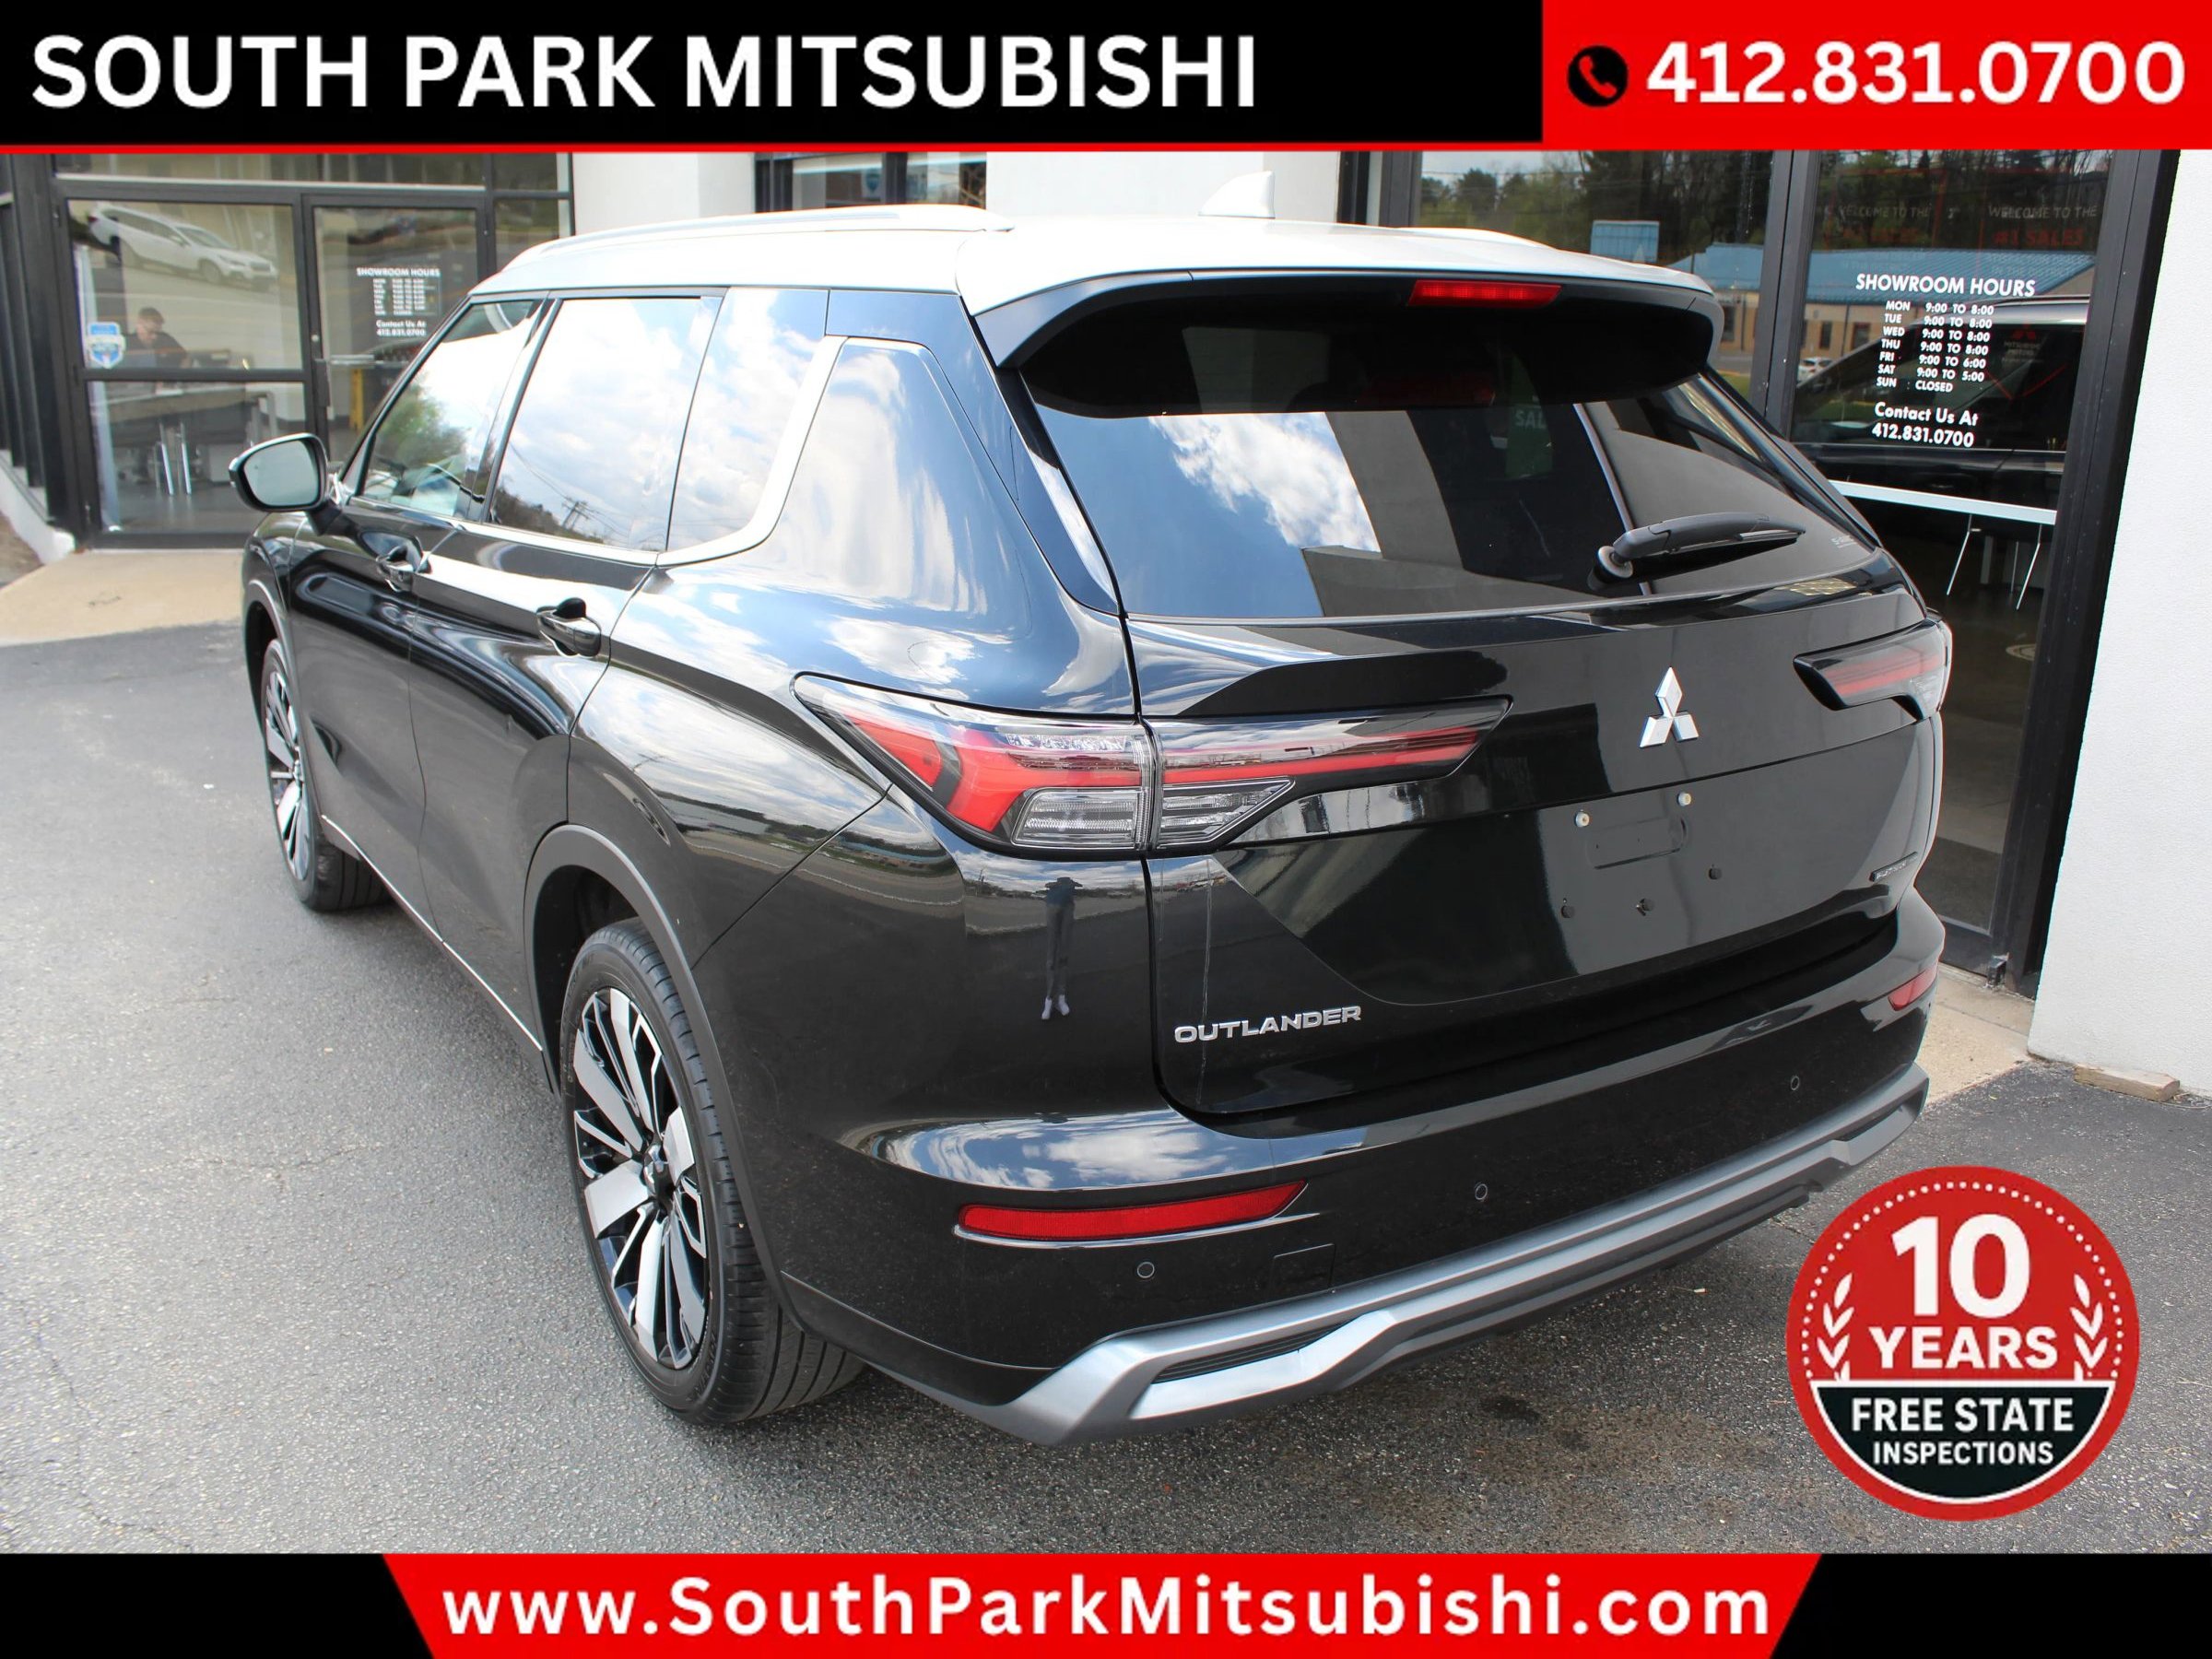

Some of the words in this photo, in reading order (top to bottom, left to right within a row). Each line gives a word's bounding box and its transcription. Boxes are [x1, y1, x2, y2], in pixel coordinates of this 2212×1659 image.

[1988, 205, 2051, 219] WELCOME
[2053, 206, 2071, 218] TO
[2074, 206, 2099, 218] THE
[1855, 273, 1964, 294] SHOWROOM
[1970, 277, 2036, 297] HOURS
[1885, 300, 1911, 312] MON
[1925, 302, 1947, 313] 9:00
[1952, 304, 1966, 314] TO
[1971, 305, 1994, 315] 8:00
[1884, 313, 1902, 324] TUE
[1924, 315, 1945, 326] 9:00
[1950, 317, 1964, 327] TO
[1969, 318, 1992, 329] 8:00
[1883, 326, 1905, 337] WED
[1922, 329, 1944, 339] 9:00
[1948, 330, 1962, 340] TO
[1967, 331, 1991, 342] 8:00
[1881, 338, 1900, 349] THU
[1920, 342, 1942, 352] 9:00
[1947, 343, 1960, 353] TO
[1965, 345, 1989, 356] 8:00
[1879, 351, 1895, 362] FRI
[1919, 355, 1940, 366] 9:00
[1945, 357, 1959, 367] TO
[1963, 358, 1986, 369] 6:00
[1877, 364, 1896, 375] SAT
[1917, 367, 1938, 379] 9:00
[1942, 369, 1956, 380] TO
[1962, 371, 1984, 382] 5:00
[1876, 377, 1897, 388] SUN
[1915, 381, 1953, 393] CLOSED
[1875, 401, 1932, 421] Contact
[1936, 407, 1955, 424] Us
[1959, 410, 1979, 427] At
[1872, 422, 1974, 448] 412.831.0700
[1174, 1006, 1361, 1043] OUTLANDER
